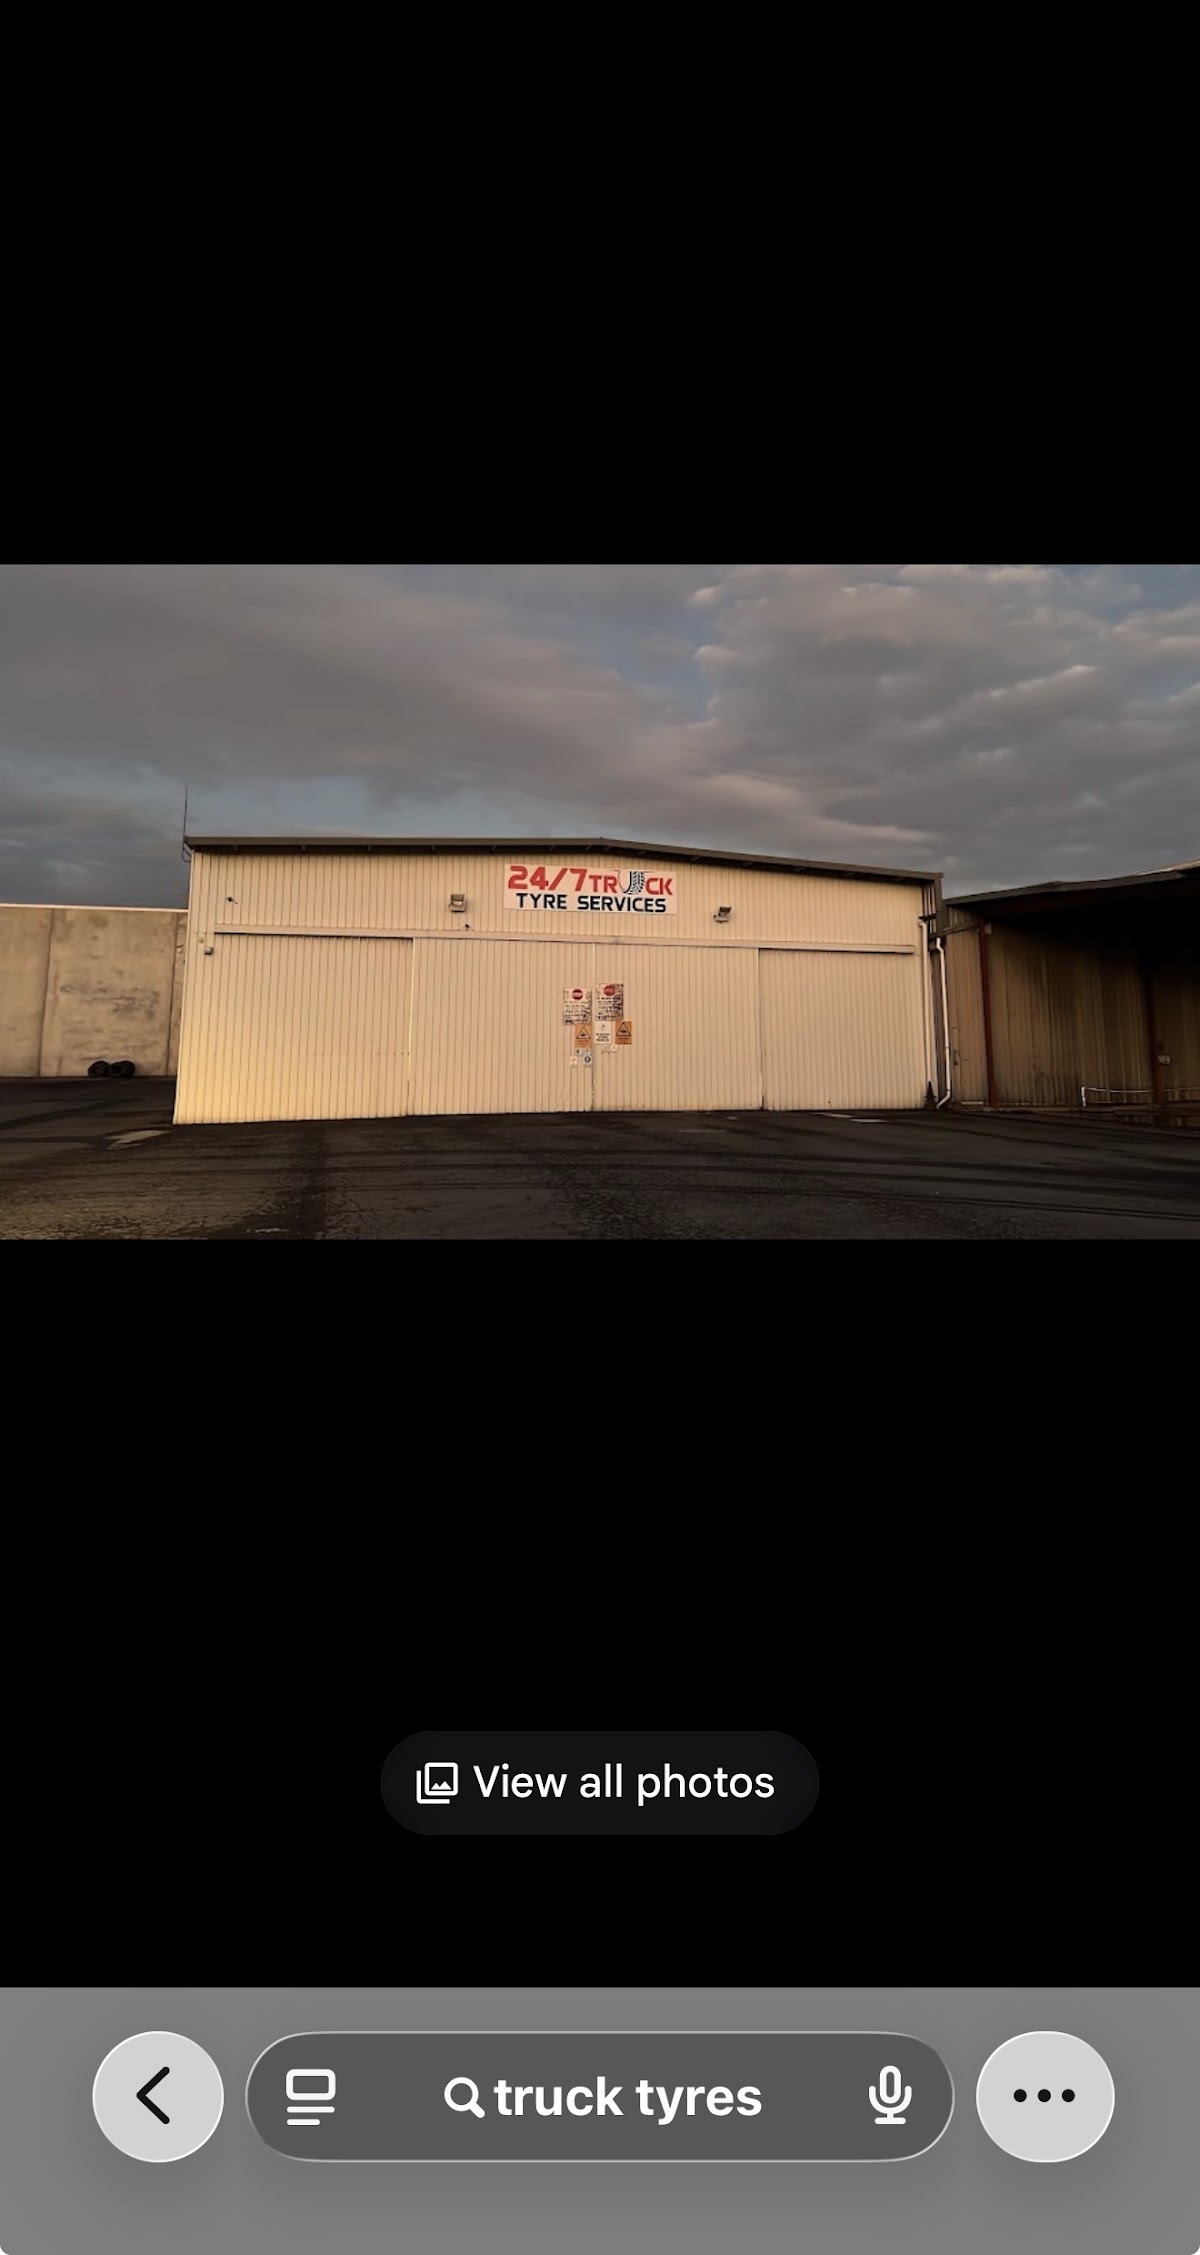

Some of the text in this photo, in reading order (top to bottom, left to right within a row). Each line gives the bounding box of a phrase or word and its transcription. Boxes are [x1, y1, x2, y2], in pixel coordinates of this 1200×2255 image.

[508, 865, 588, 892] 24/7
[516, 892, 667, 913] TYRE SERVICES
